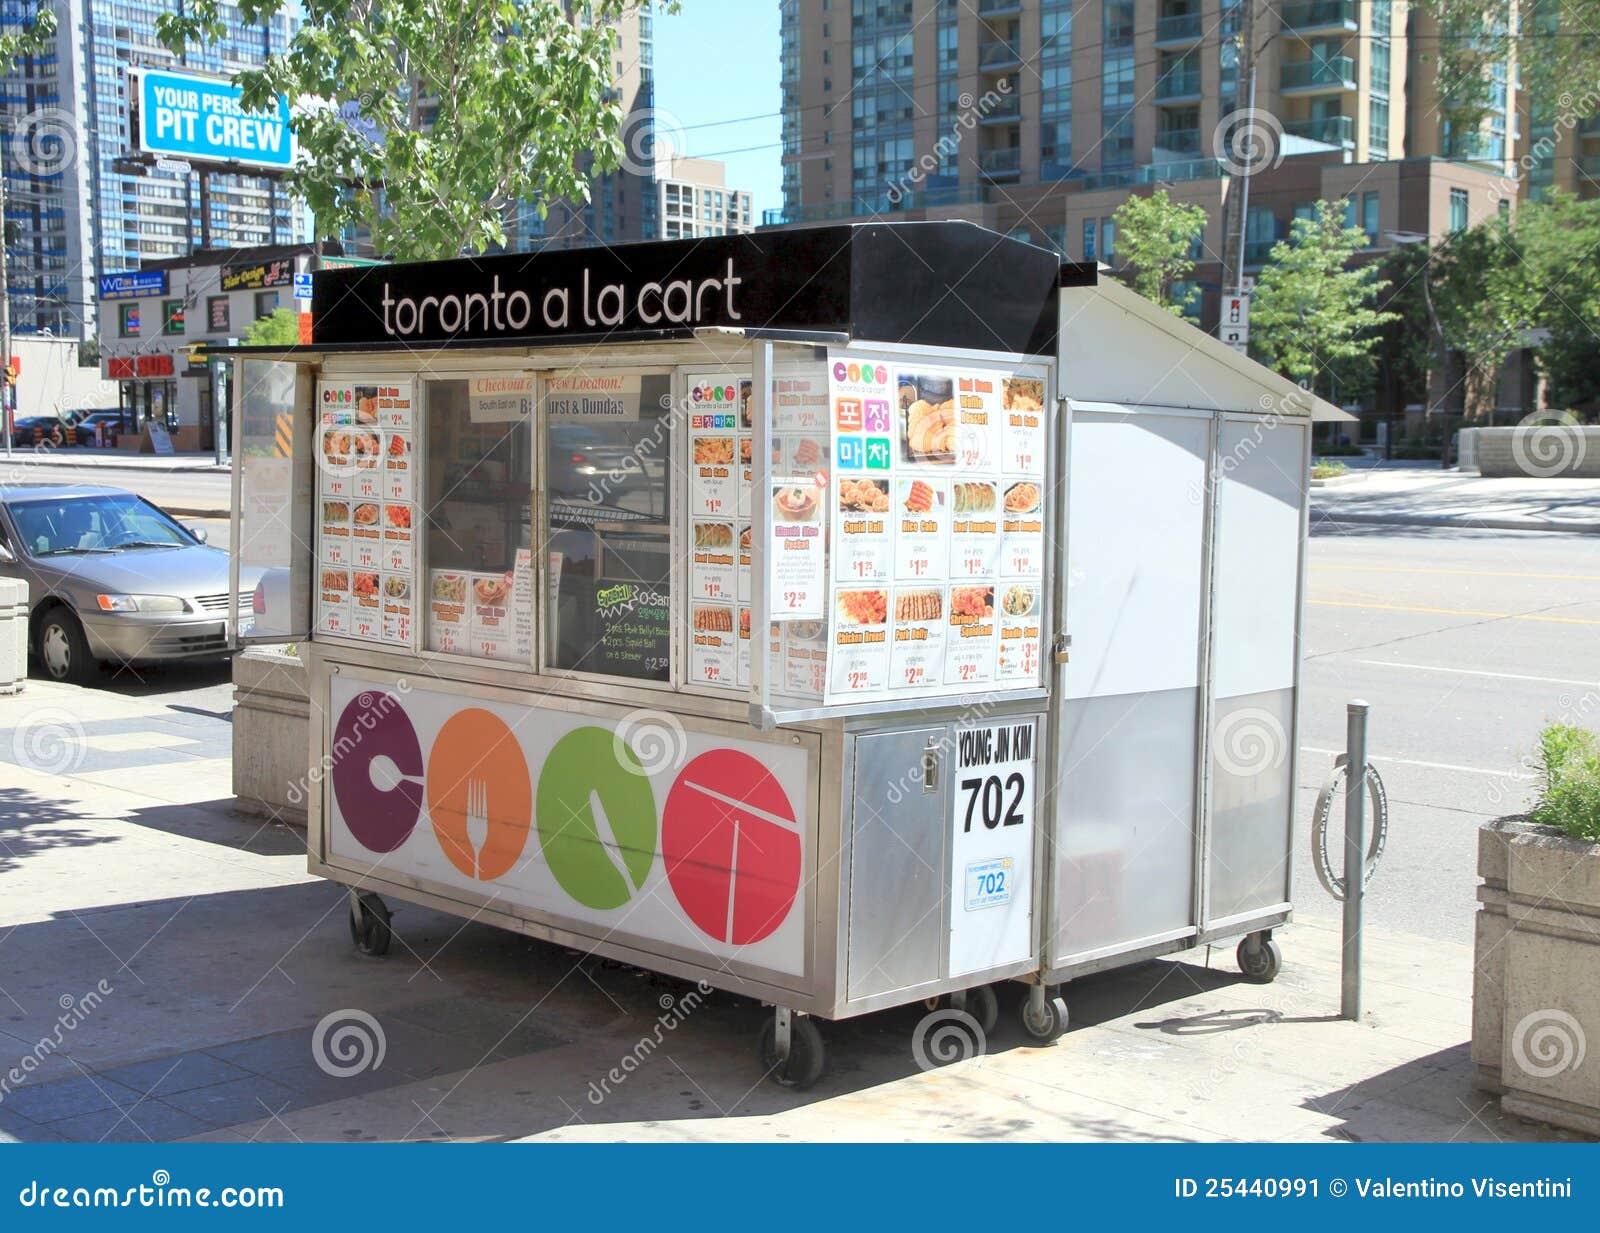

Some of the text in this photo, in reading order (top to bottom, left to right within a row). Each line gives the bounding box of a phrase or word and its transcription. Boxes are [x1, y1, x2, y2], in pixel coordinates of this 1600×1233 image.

[153, 86, 198, 111] YOUR
[156, 107, 282, 153] PIT CREW
[382, 257, 741, 336] toronto a la cart
[582, 398, 624, 415] Dundas
[784, 592, 806, 607] $2.50
[837, 631, 863, 645] Chicken
[848, 672, 867, 689] $2.00
[905, 667, 923, 684] $2.00
[959, 724, 1032, 768] YOUNG JIN KIM
[961, 772, 1025, 833] 702
[977, 871, 1005, 897] 702
